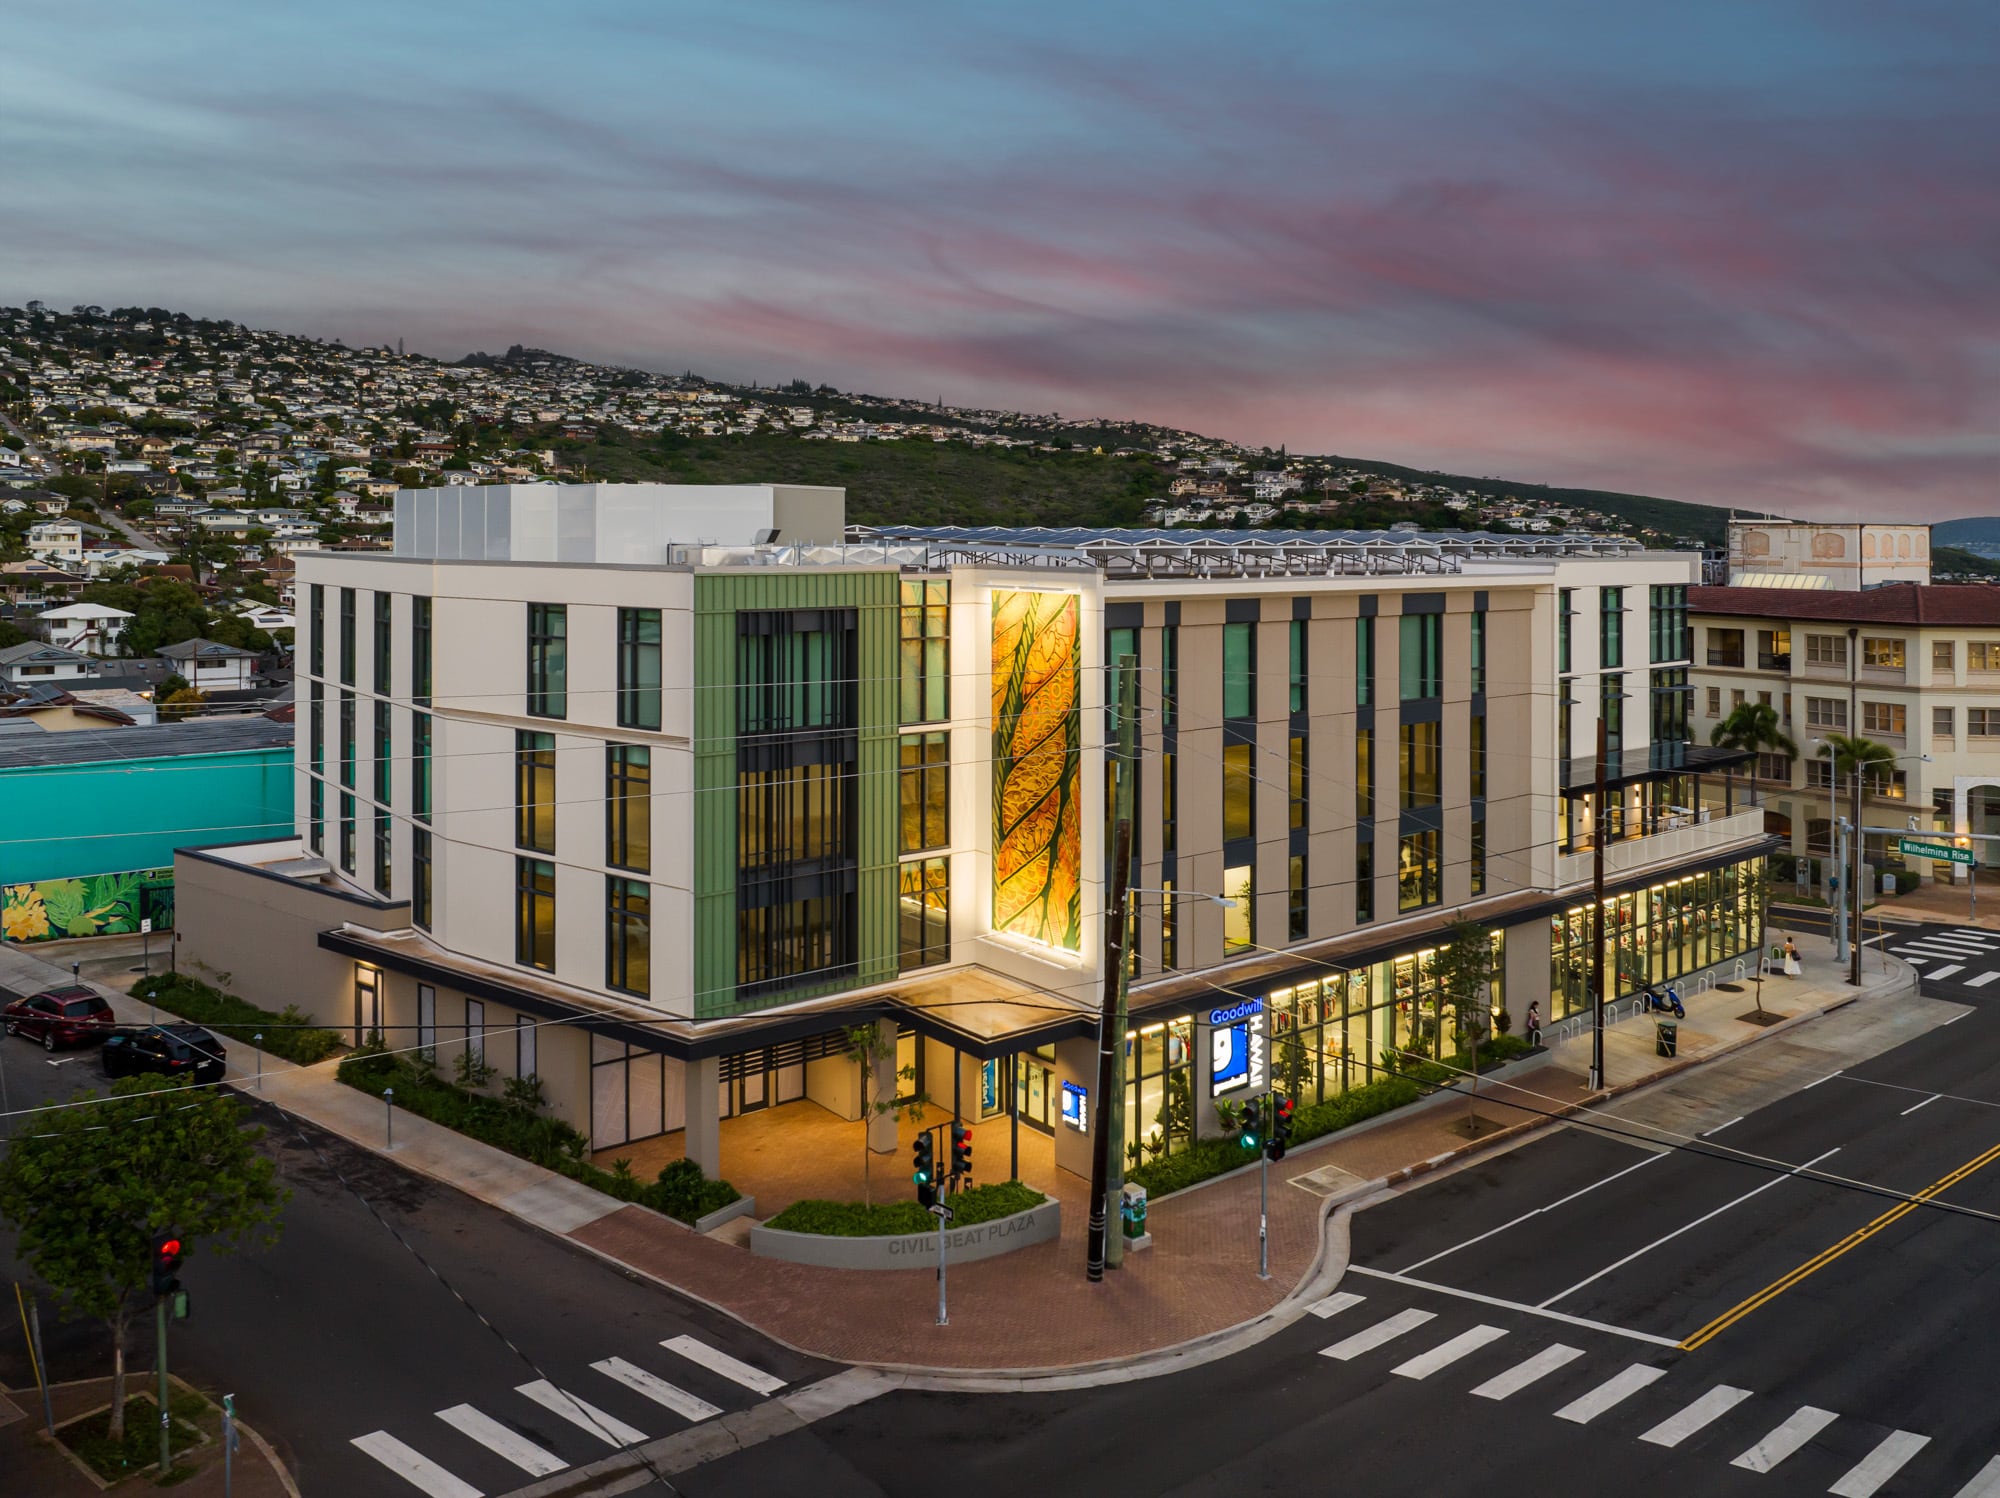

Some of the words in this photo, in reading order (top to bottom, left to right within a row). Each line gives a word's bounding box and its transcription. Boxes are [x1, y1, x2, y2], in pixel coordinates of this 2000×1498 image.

[1903, 842, 1948, 858] Wilhelmina
[1951, 851, 1970, 861] Rise
[1210, 997, 1264, 1024] Goodwill
[1249, 1014, 1264, 1088] HAWAII
[1062, 1080, 1088, 1096] Goodwill
[887, 1239, 935, 1255] CIVIL
[988, 1214, 1036, 1241] PLAZA
